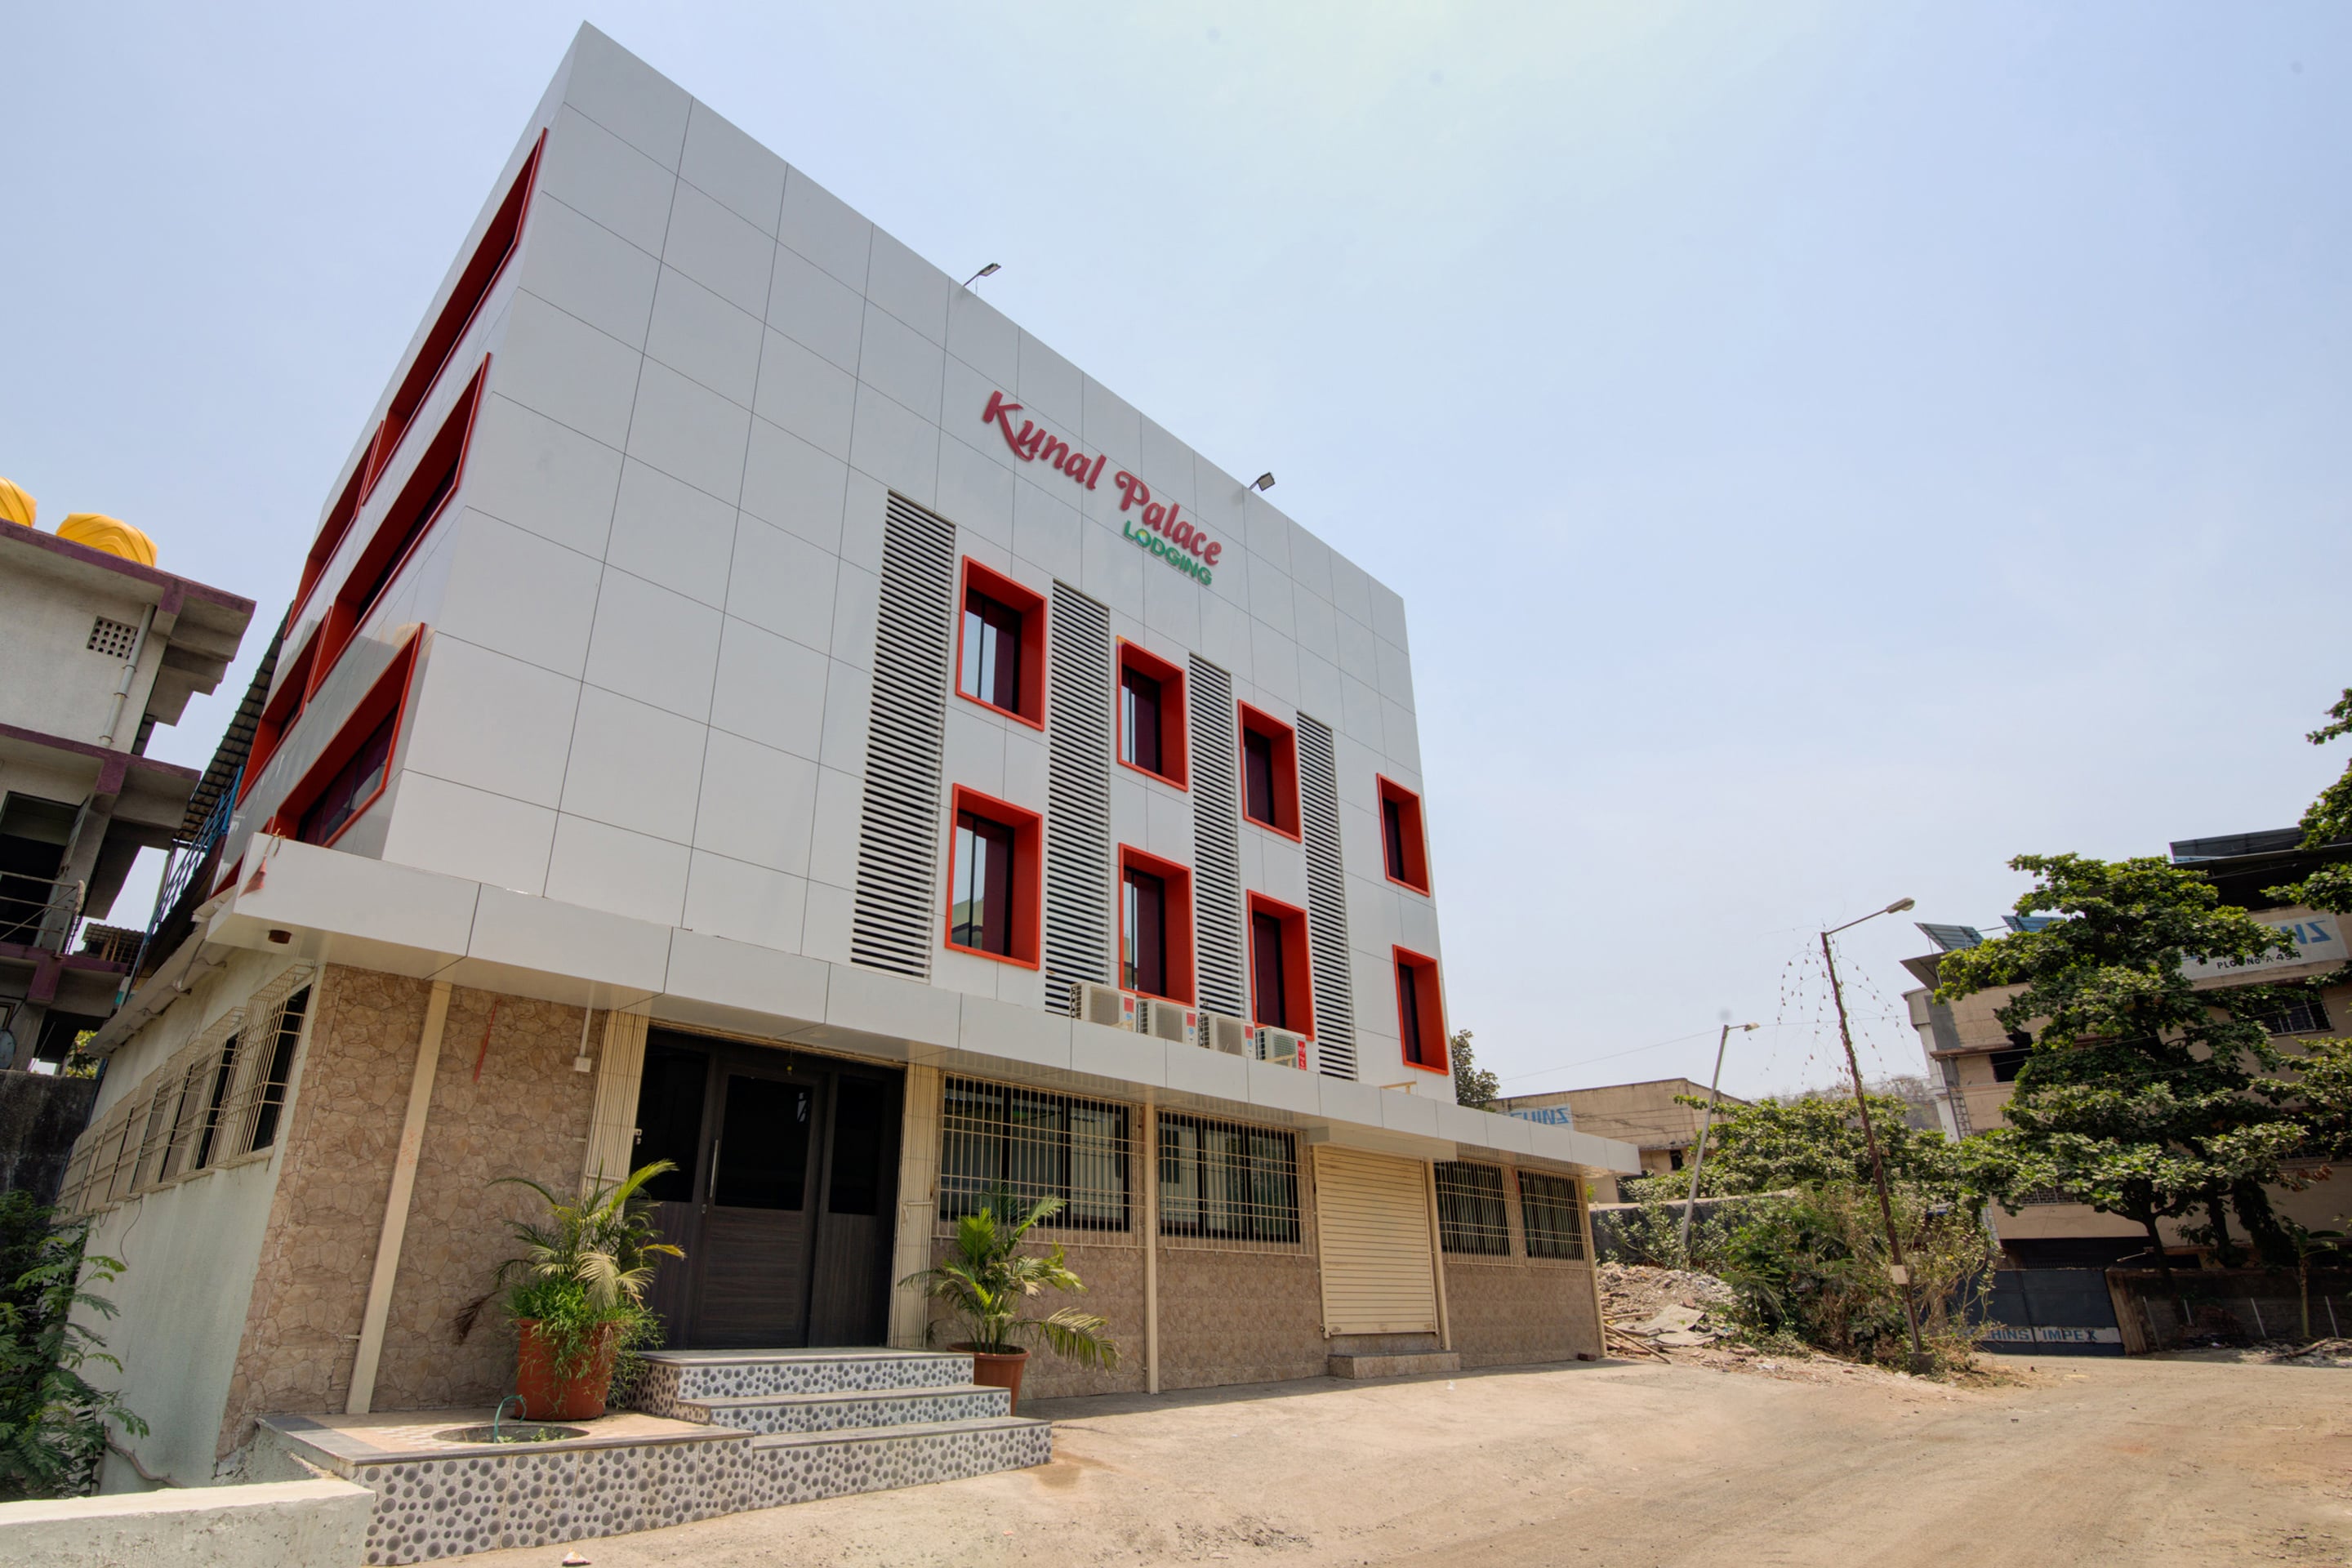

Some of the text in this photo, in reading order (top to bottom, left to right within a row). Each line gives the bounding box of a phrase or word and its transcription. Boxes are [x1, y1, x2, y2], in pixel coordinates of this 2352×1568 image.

[982, 390, 1223, 566] Kunal Palace
[1123, 519, 1214, 586] LODGING
[2216, 959, 2243, 970] PLO
[2042, 1329, 2098, 1341] IMPEX
